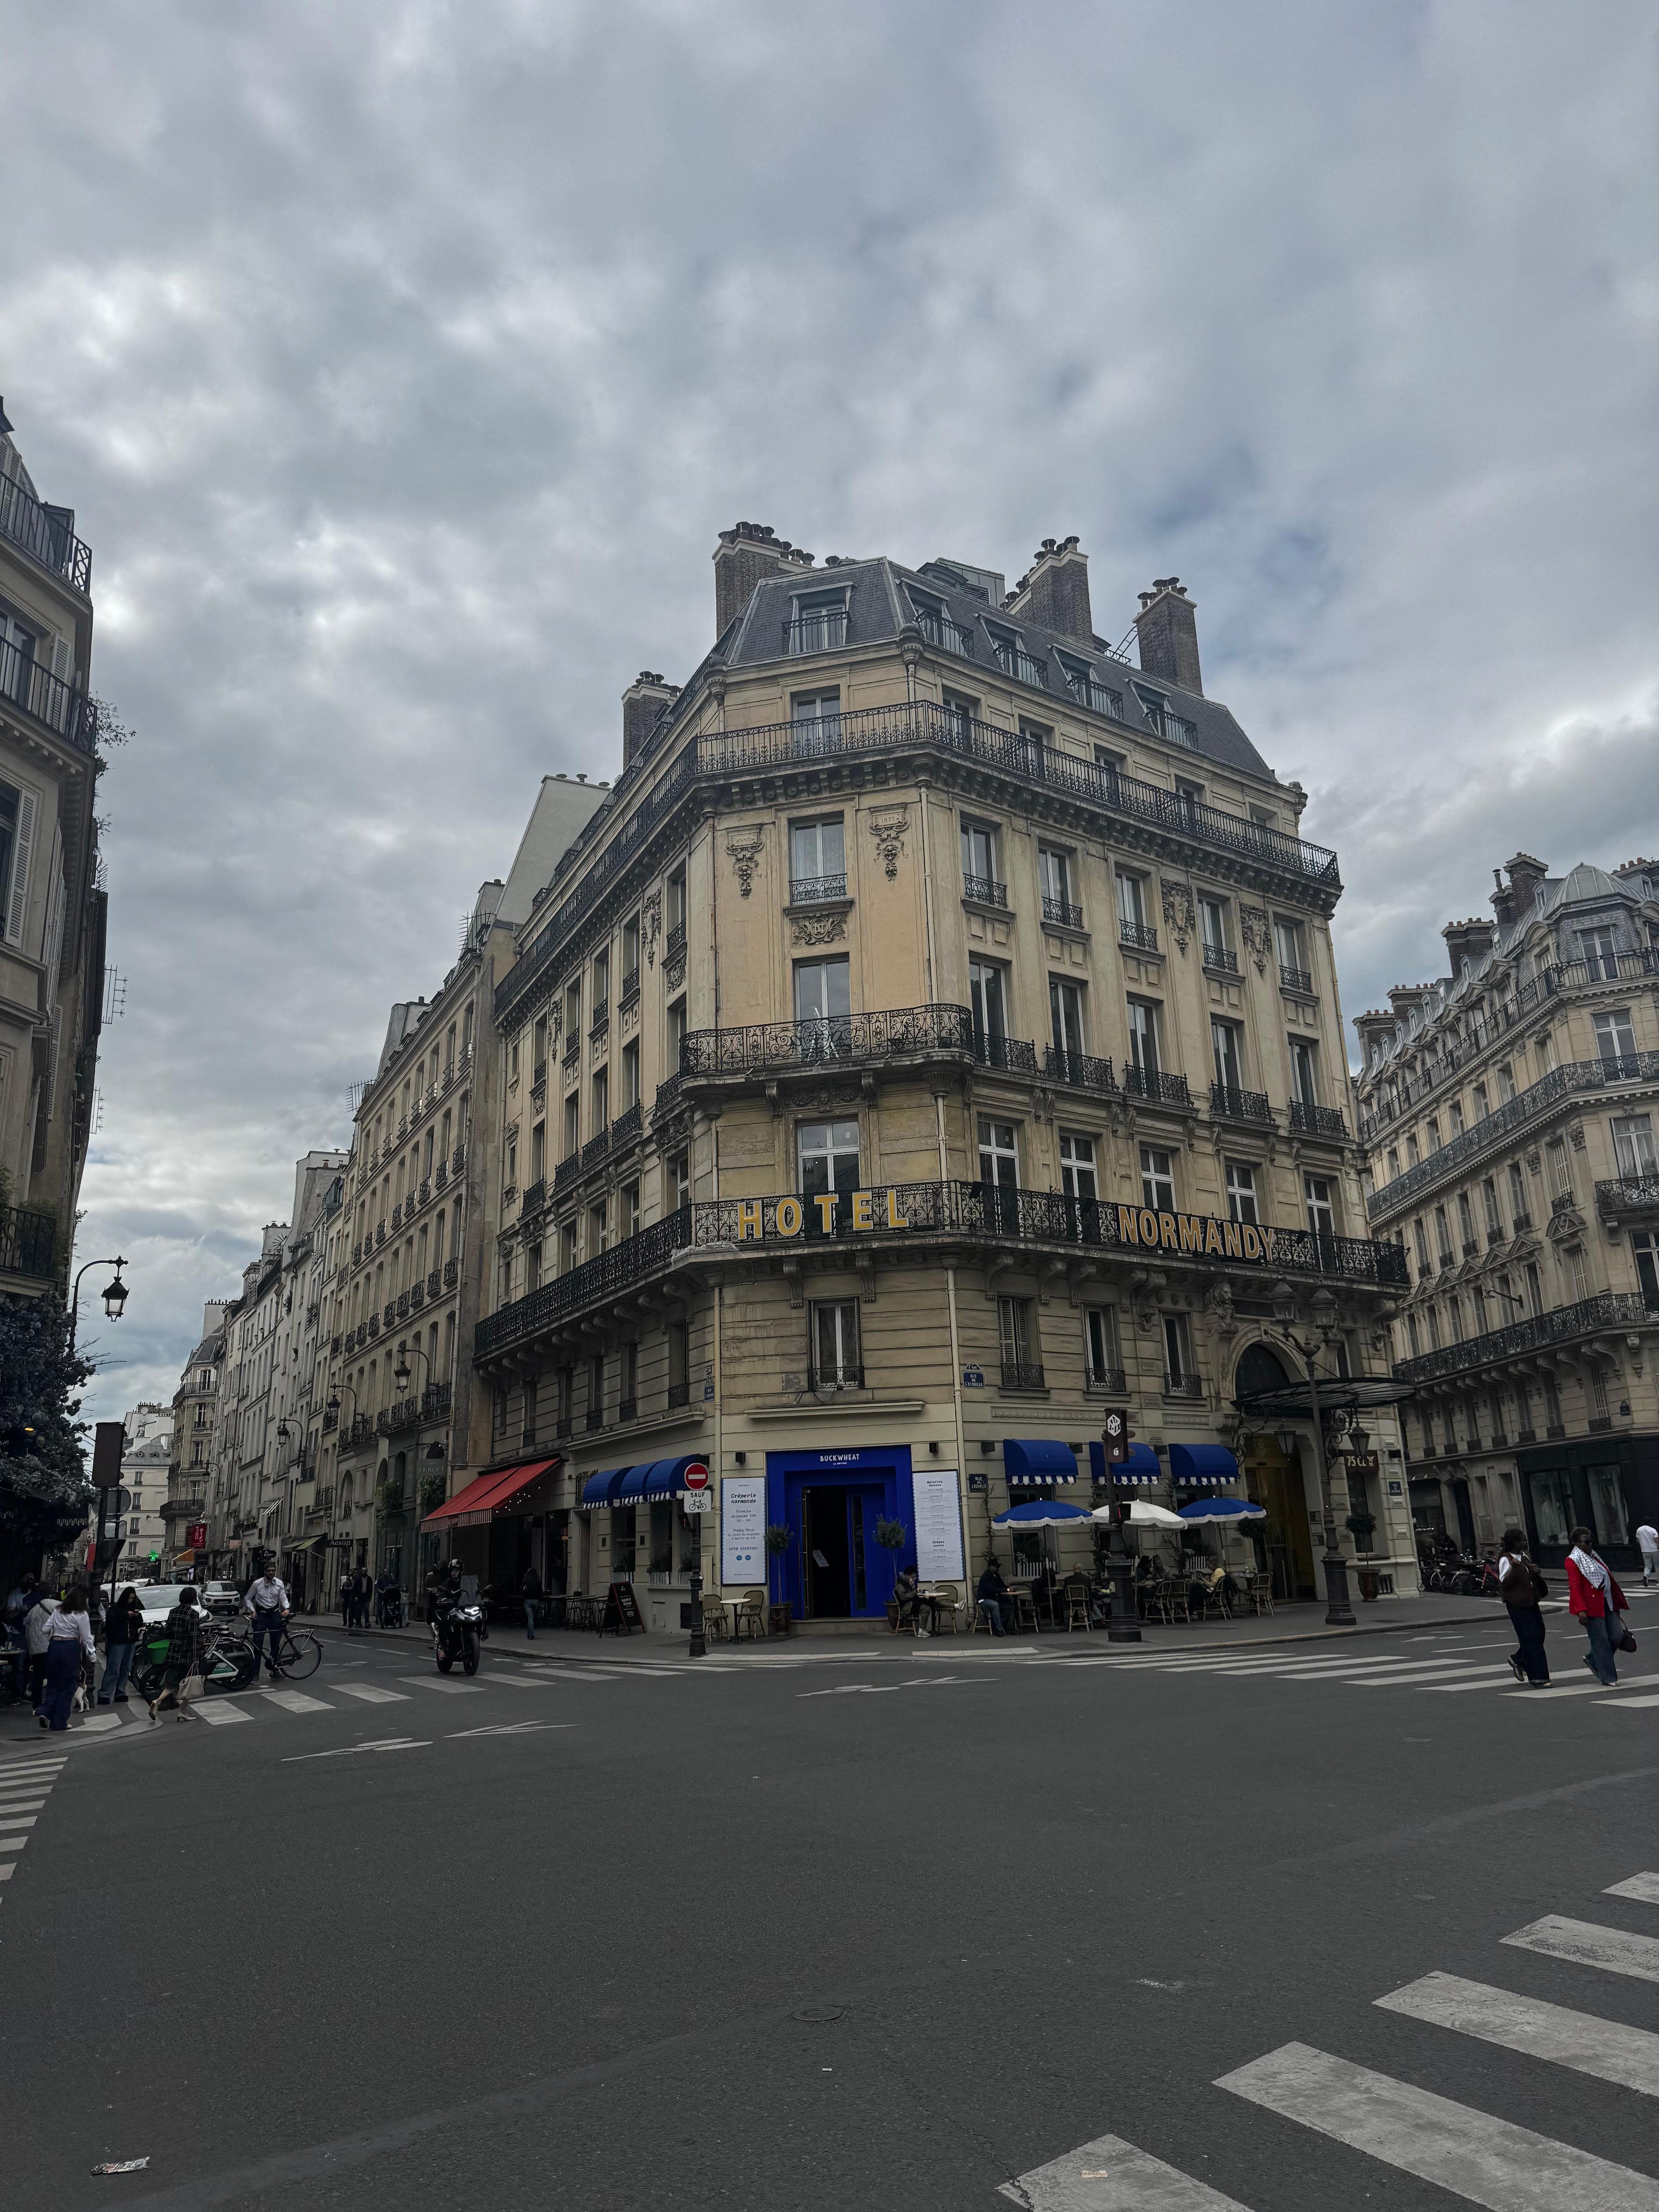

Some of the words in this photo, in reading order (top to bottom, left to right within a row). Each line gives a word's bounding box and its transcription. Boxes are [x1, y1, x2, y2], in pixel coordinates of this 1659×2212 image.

[737, 1189, 909, 1240] HOTEL
[1118, 1206, 1274, 1262] NORMANDY
[820, 1454, 860, 1462] BUCKWHEAT
[1346, 1456, 1356, 1467] 75
